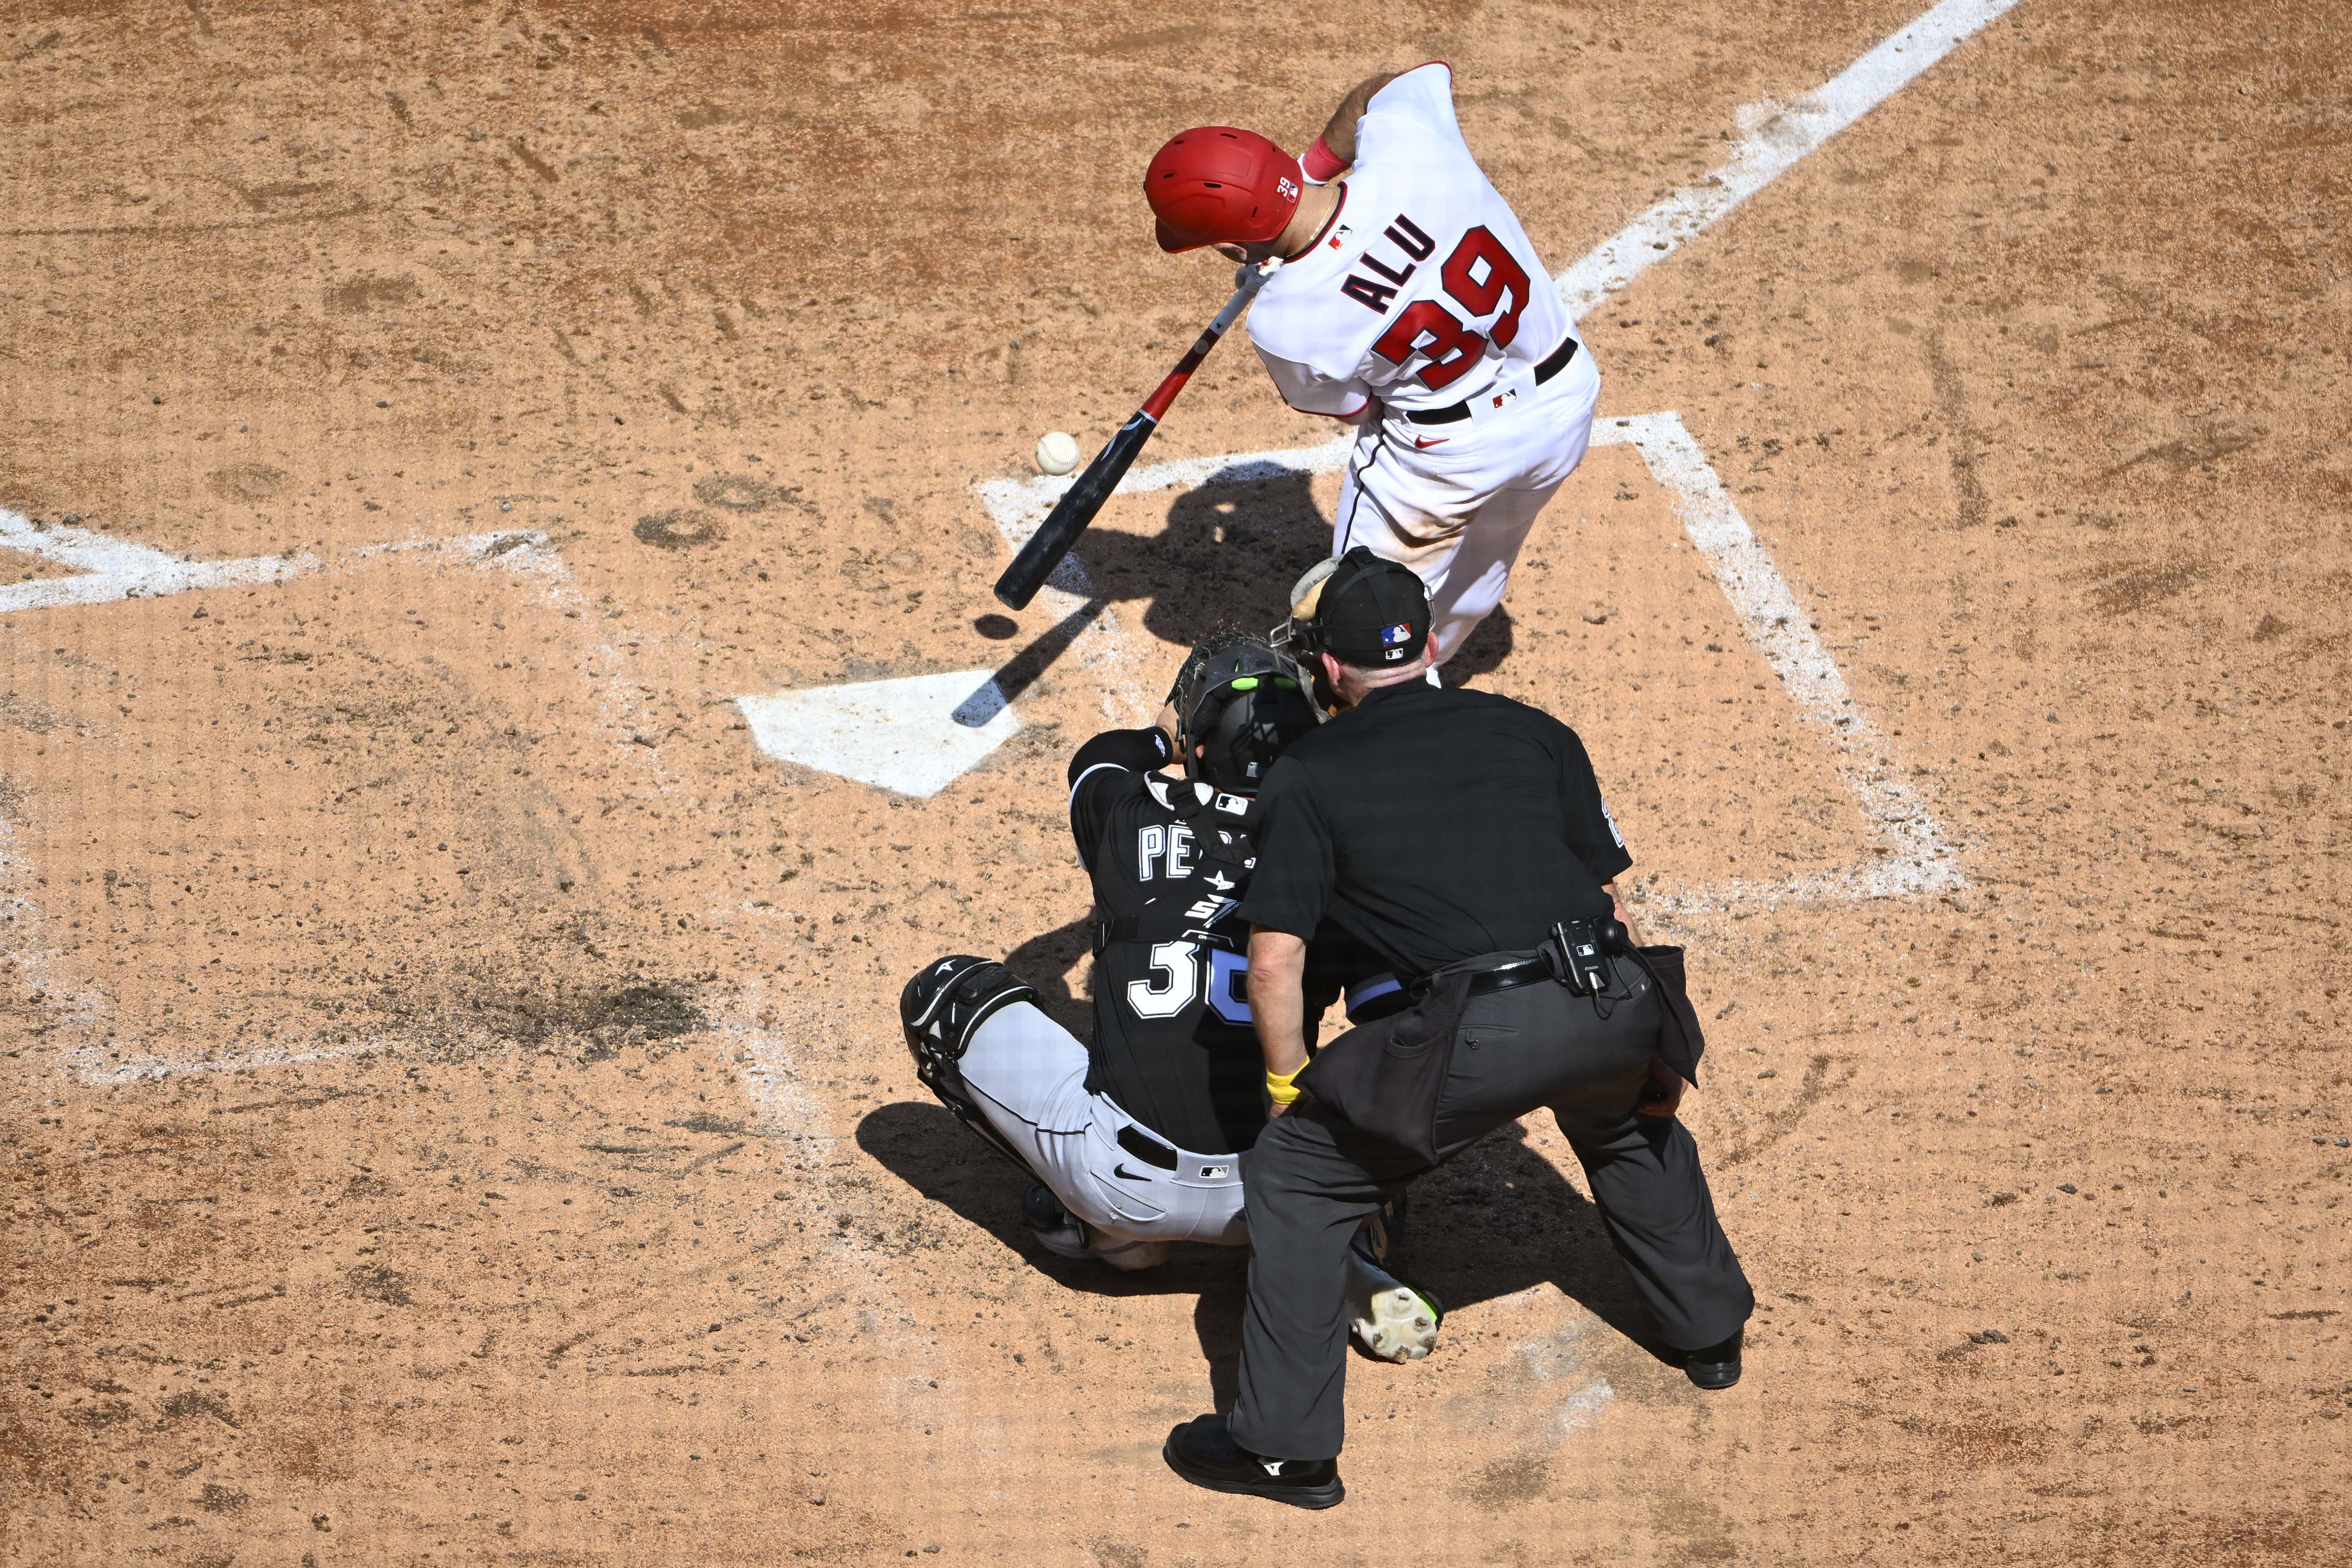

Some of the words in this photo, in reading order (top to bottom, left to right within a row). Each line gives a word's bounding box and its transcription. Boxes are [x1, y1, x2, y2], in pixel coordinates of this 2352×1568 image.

[1276, 177, 1290, 197] 39
[1340, 213, 1436, 315] ALU
[1370, 224, 1531, 392] 39
